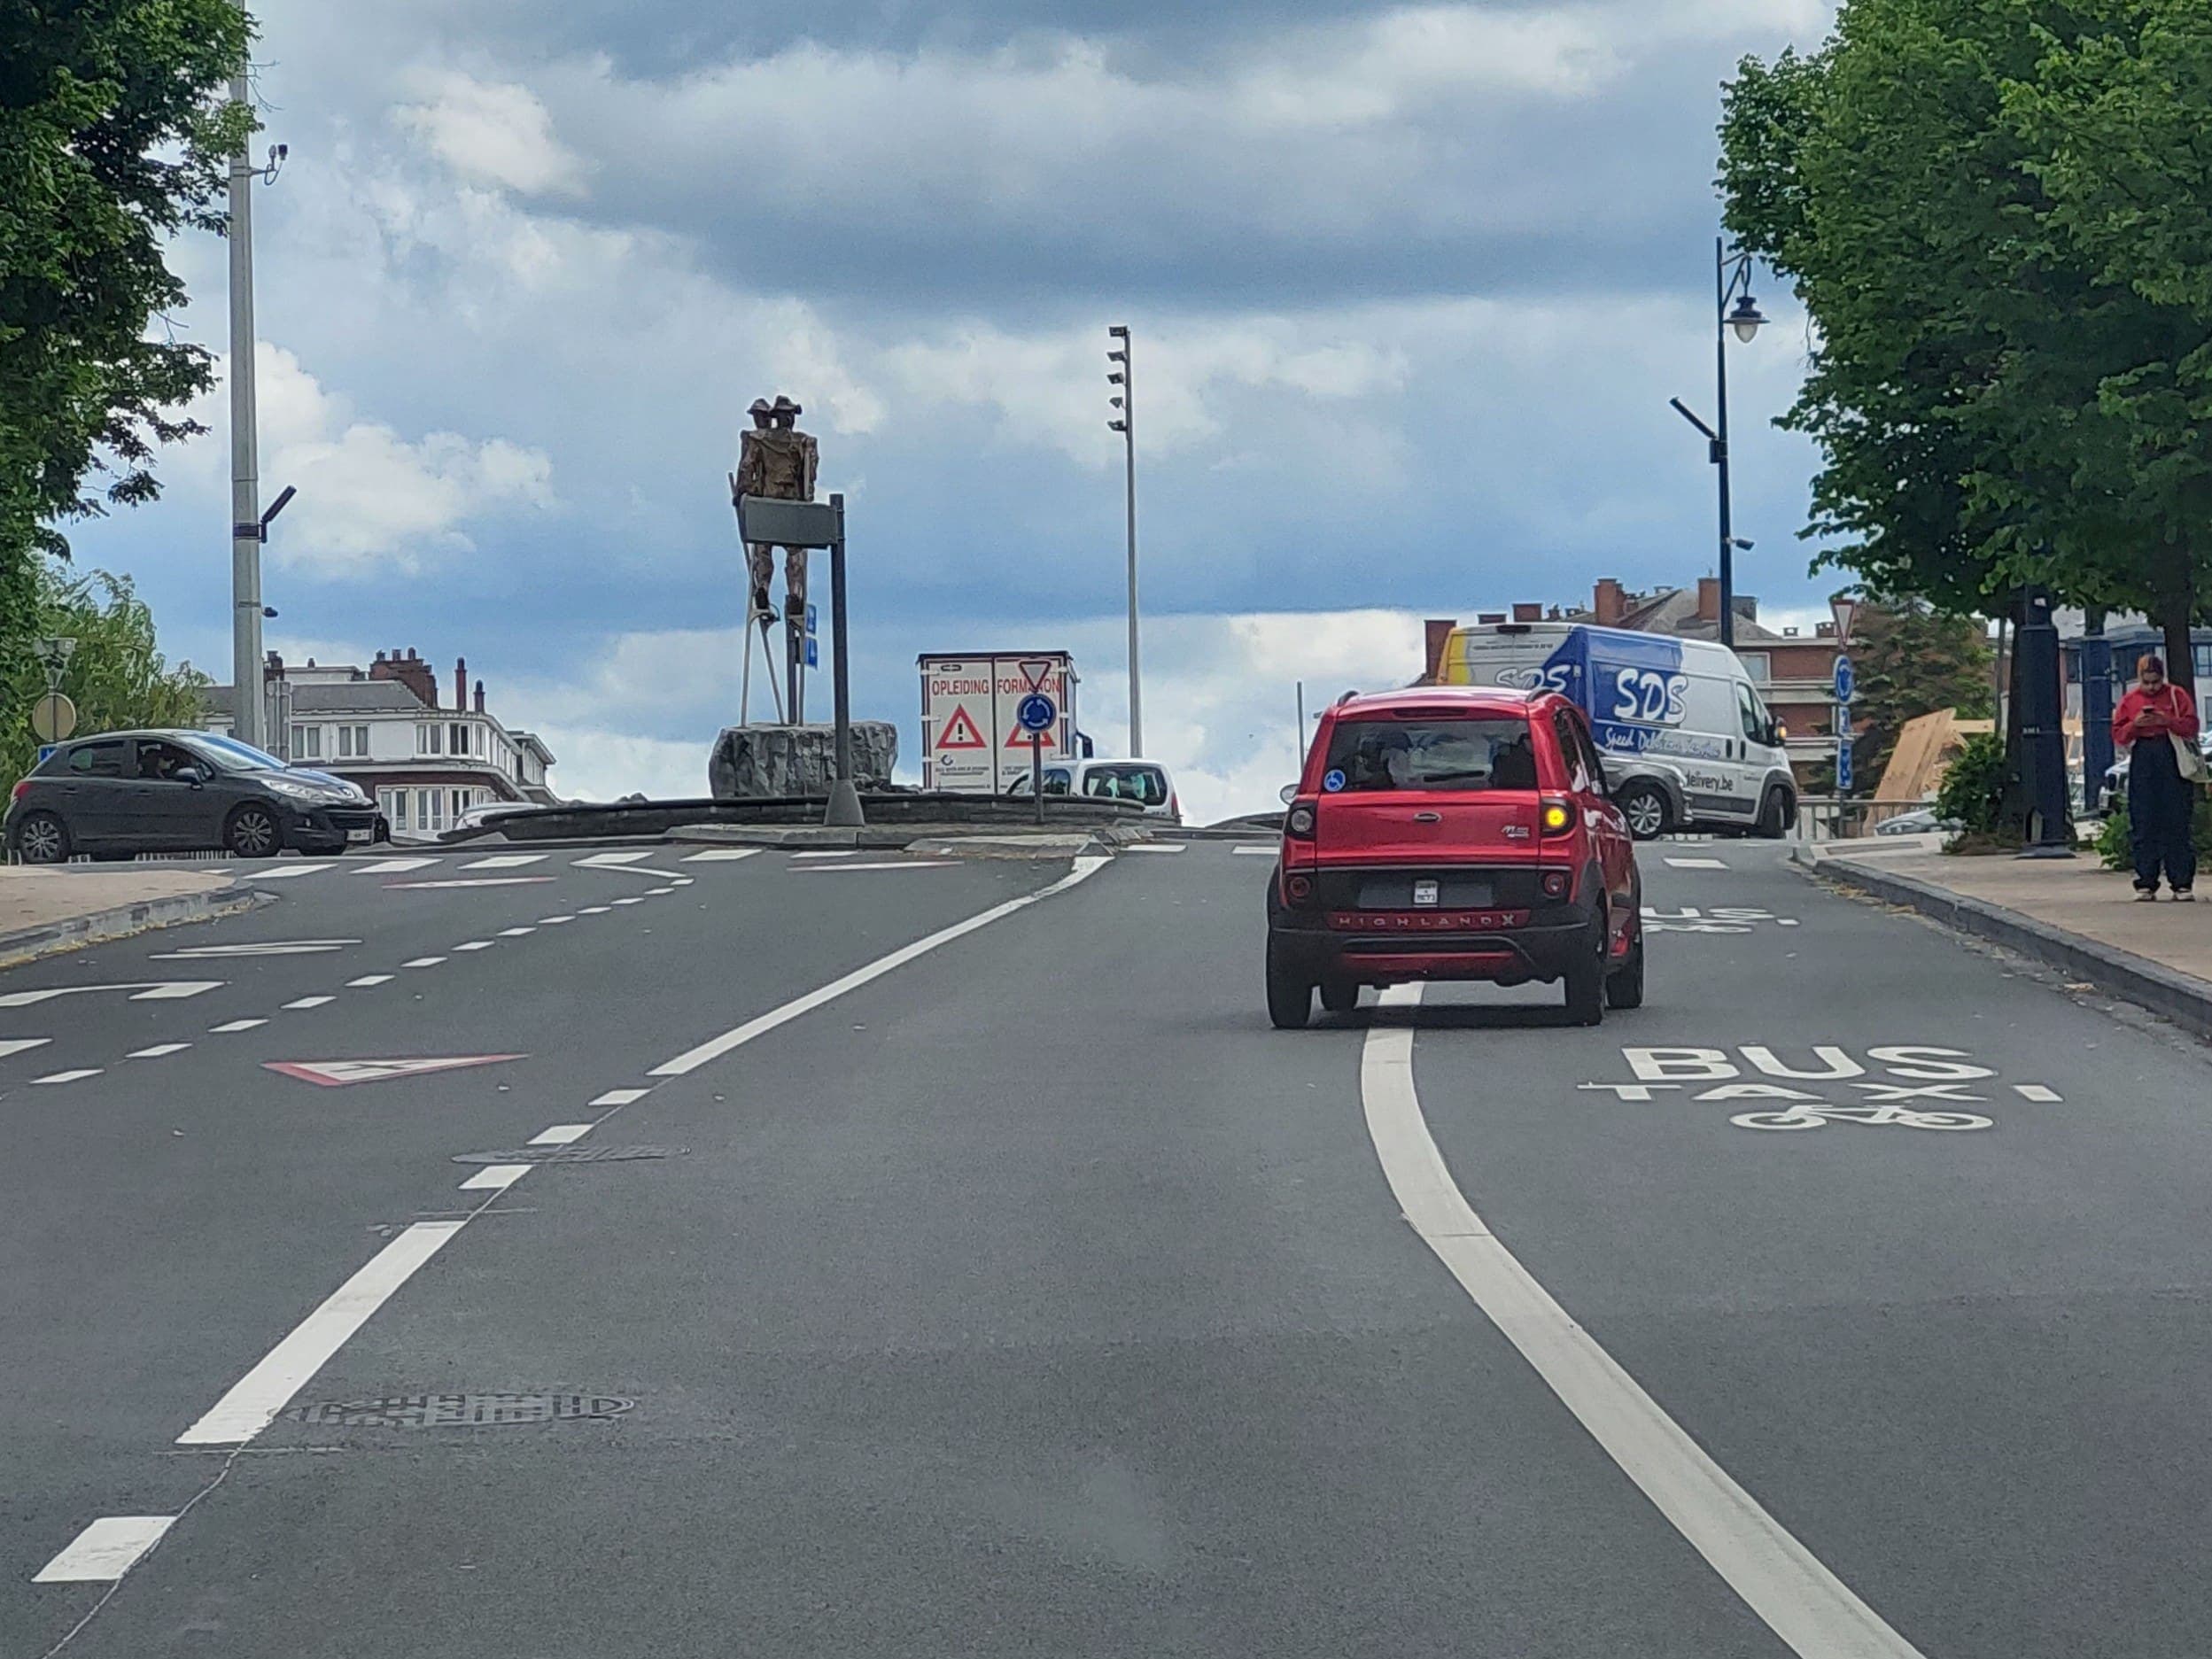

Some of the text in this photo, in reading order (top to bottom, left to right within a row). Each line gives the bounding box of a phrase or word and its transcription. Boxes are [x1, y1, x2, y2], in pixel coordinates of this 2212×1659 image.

[932, 677, 1061, 695] OPLEIDING FORMON
[1614, 668, 1688, 725] SDS
[1605, 726, 1635, 752] Speed
[1640, 907, 1774, 919] US
[1621, 1045, 1999, 1081] BUS
[1576, 1081, 2064, 1103] TAXI
